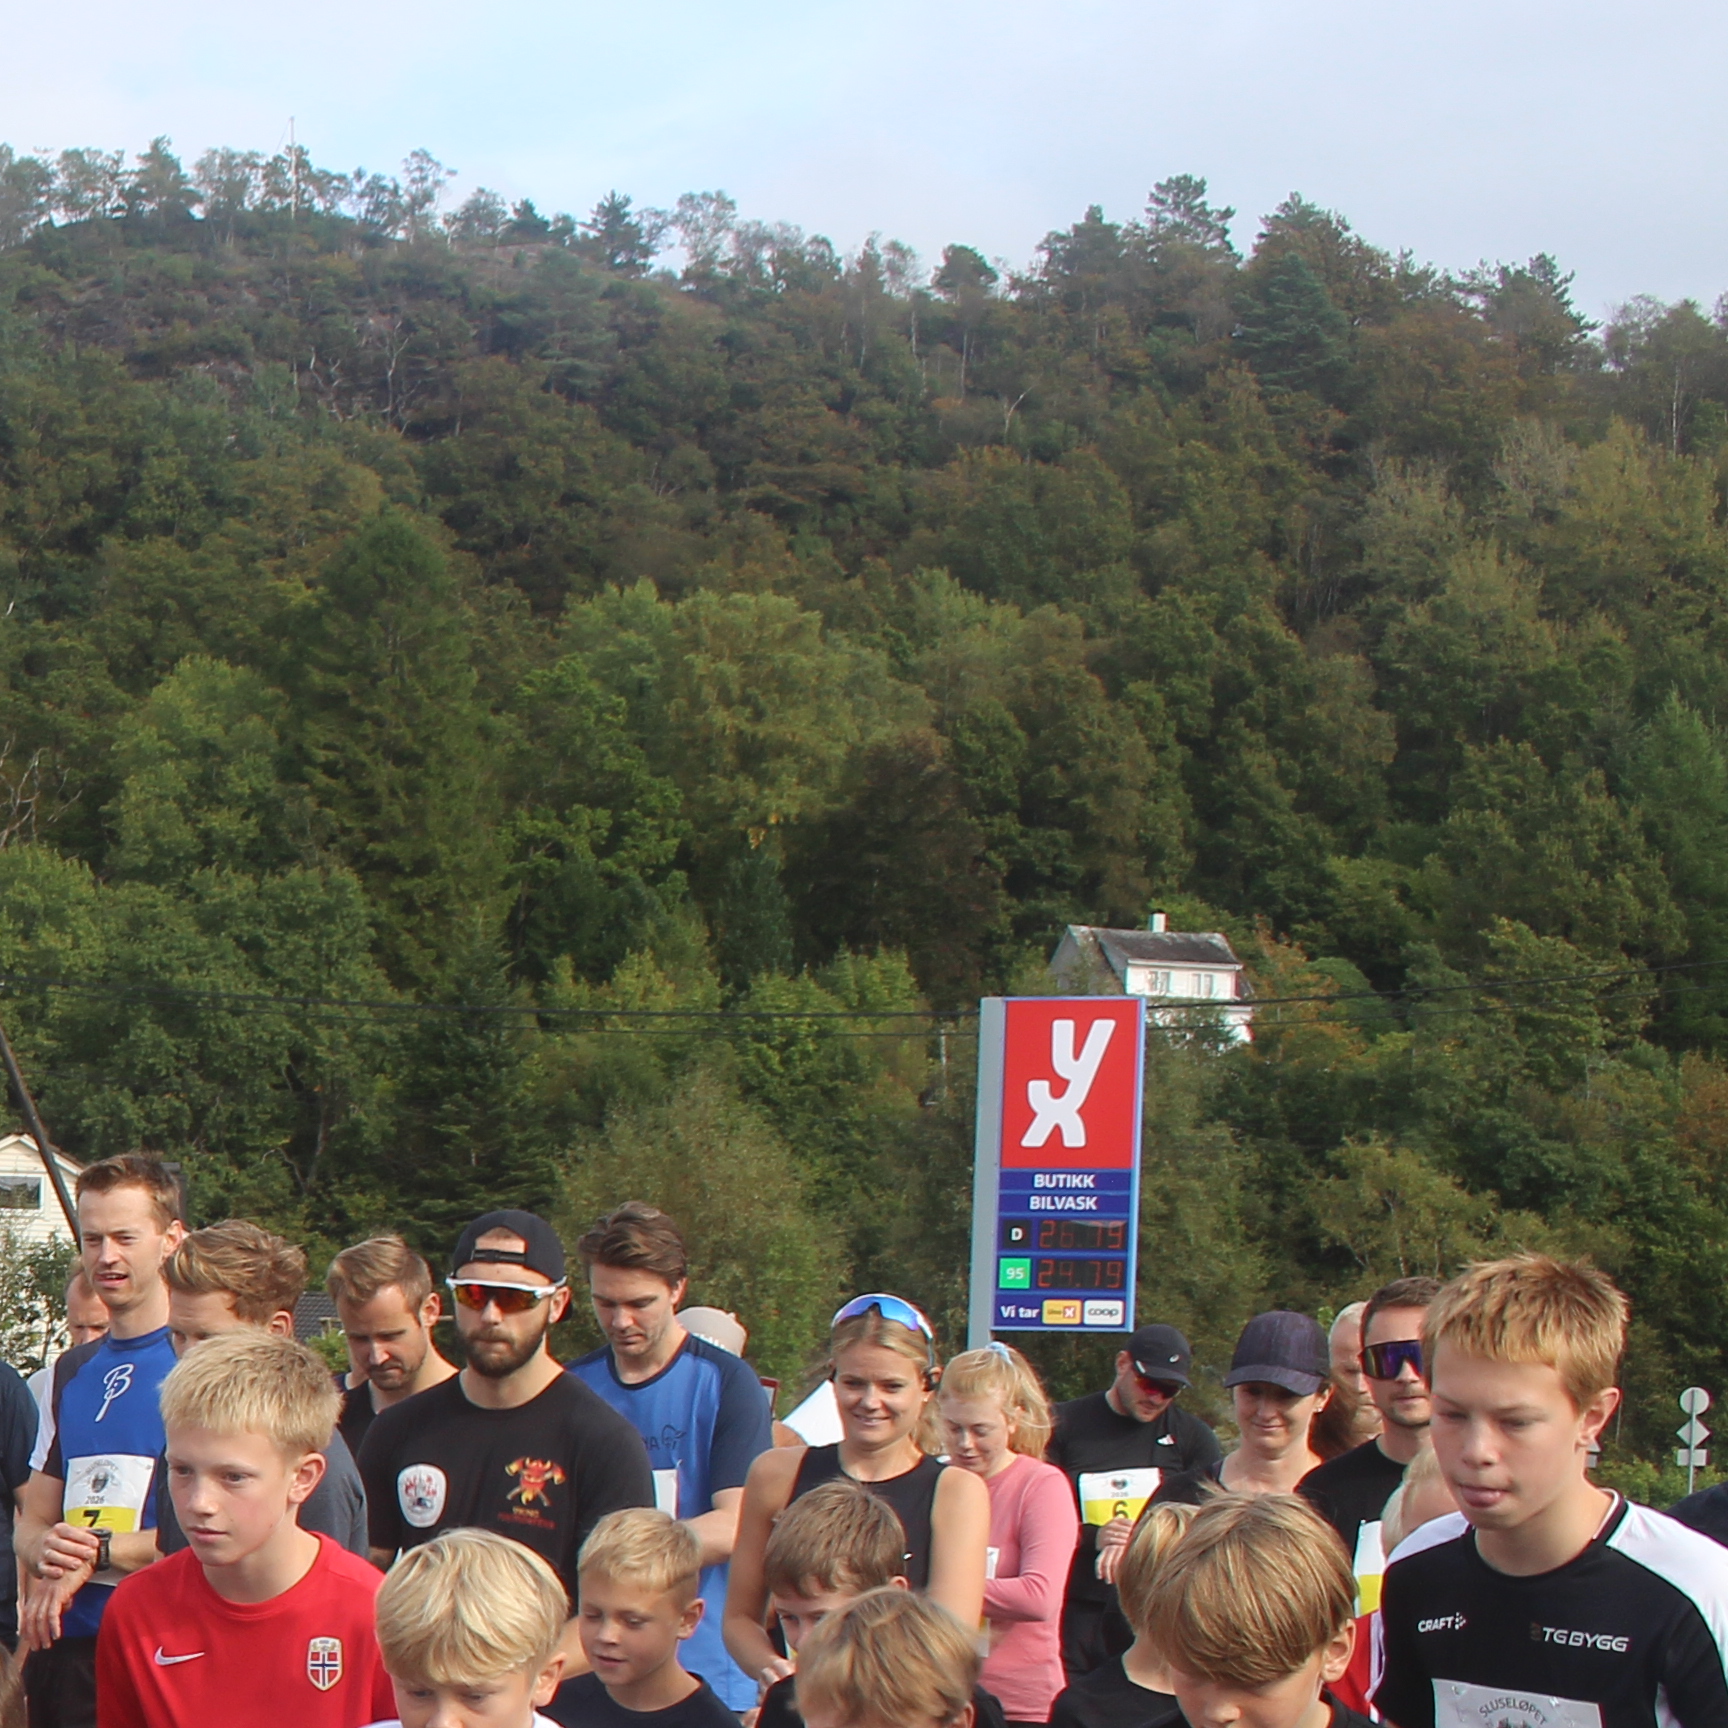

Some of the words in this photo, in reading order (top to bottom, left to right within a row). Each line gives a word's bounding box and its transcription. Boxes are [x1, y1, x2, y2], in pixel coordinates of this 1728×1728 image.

[1033, 1173, 1096, 1189] BUTIKK
[1029, 1195, 1098, 1211] BILVASK
[1010, 1227, 1024, 1242] D
[1005, 1266, 1026, 1280] 95
[1000, 1304, 1016, 1318] Vi
[1018, 1305, 1040, 1318] tar
[1087, 1307, 1120, 1317] coop
[1417, 1616, 1454, 1633] CRAFT
[1477, 1696, 1549, 1726] SLUSELØPET
